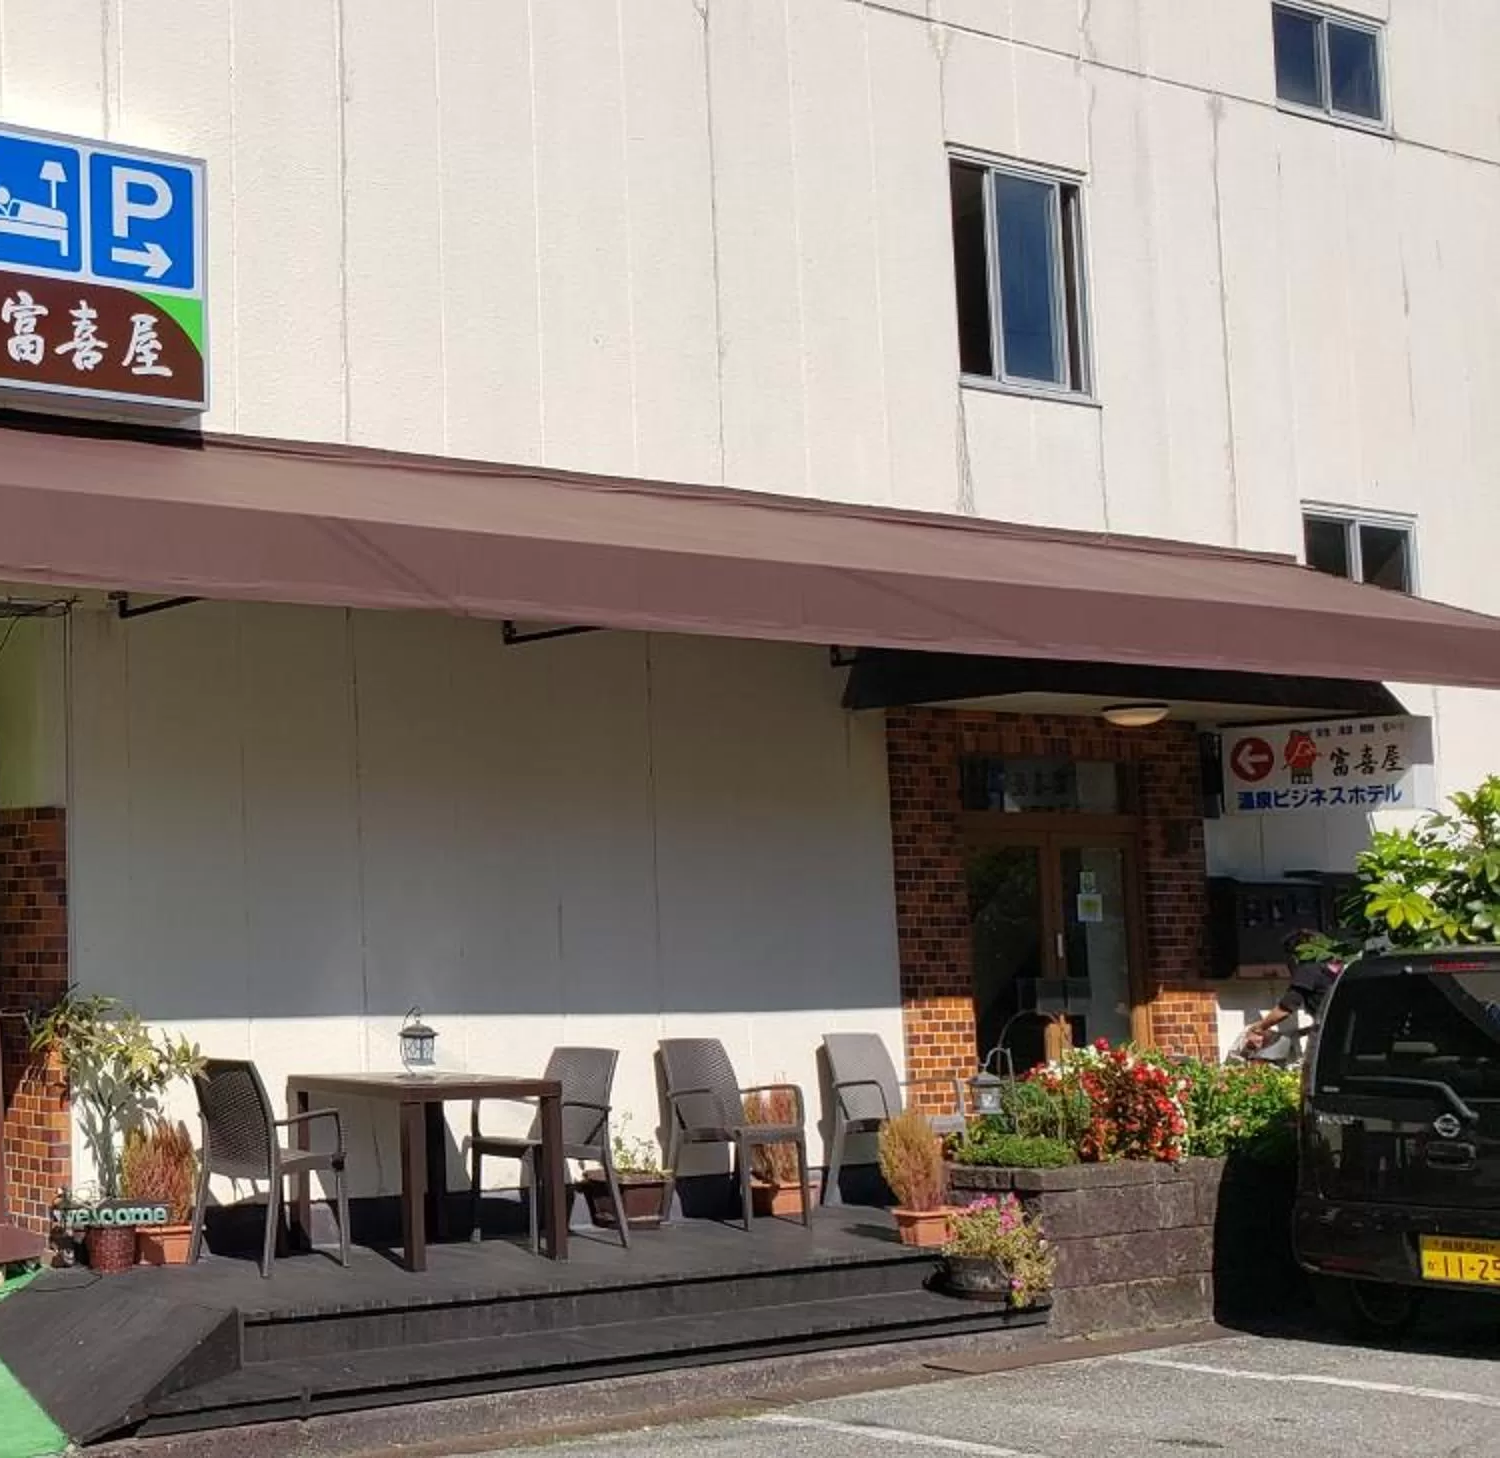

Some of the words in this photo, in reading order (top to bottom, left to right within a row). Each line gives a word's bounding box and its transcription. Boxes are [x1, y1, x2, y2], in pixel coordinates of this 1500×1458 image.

[0, 290, 174, 378] 富喜屋
[1329, 744, 1406, 777] 富喜屋
[1237, 783, 1403, 811] 温泉ビジネスホテル
